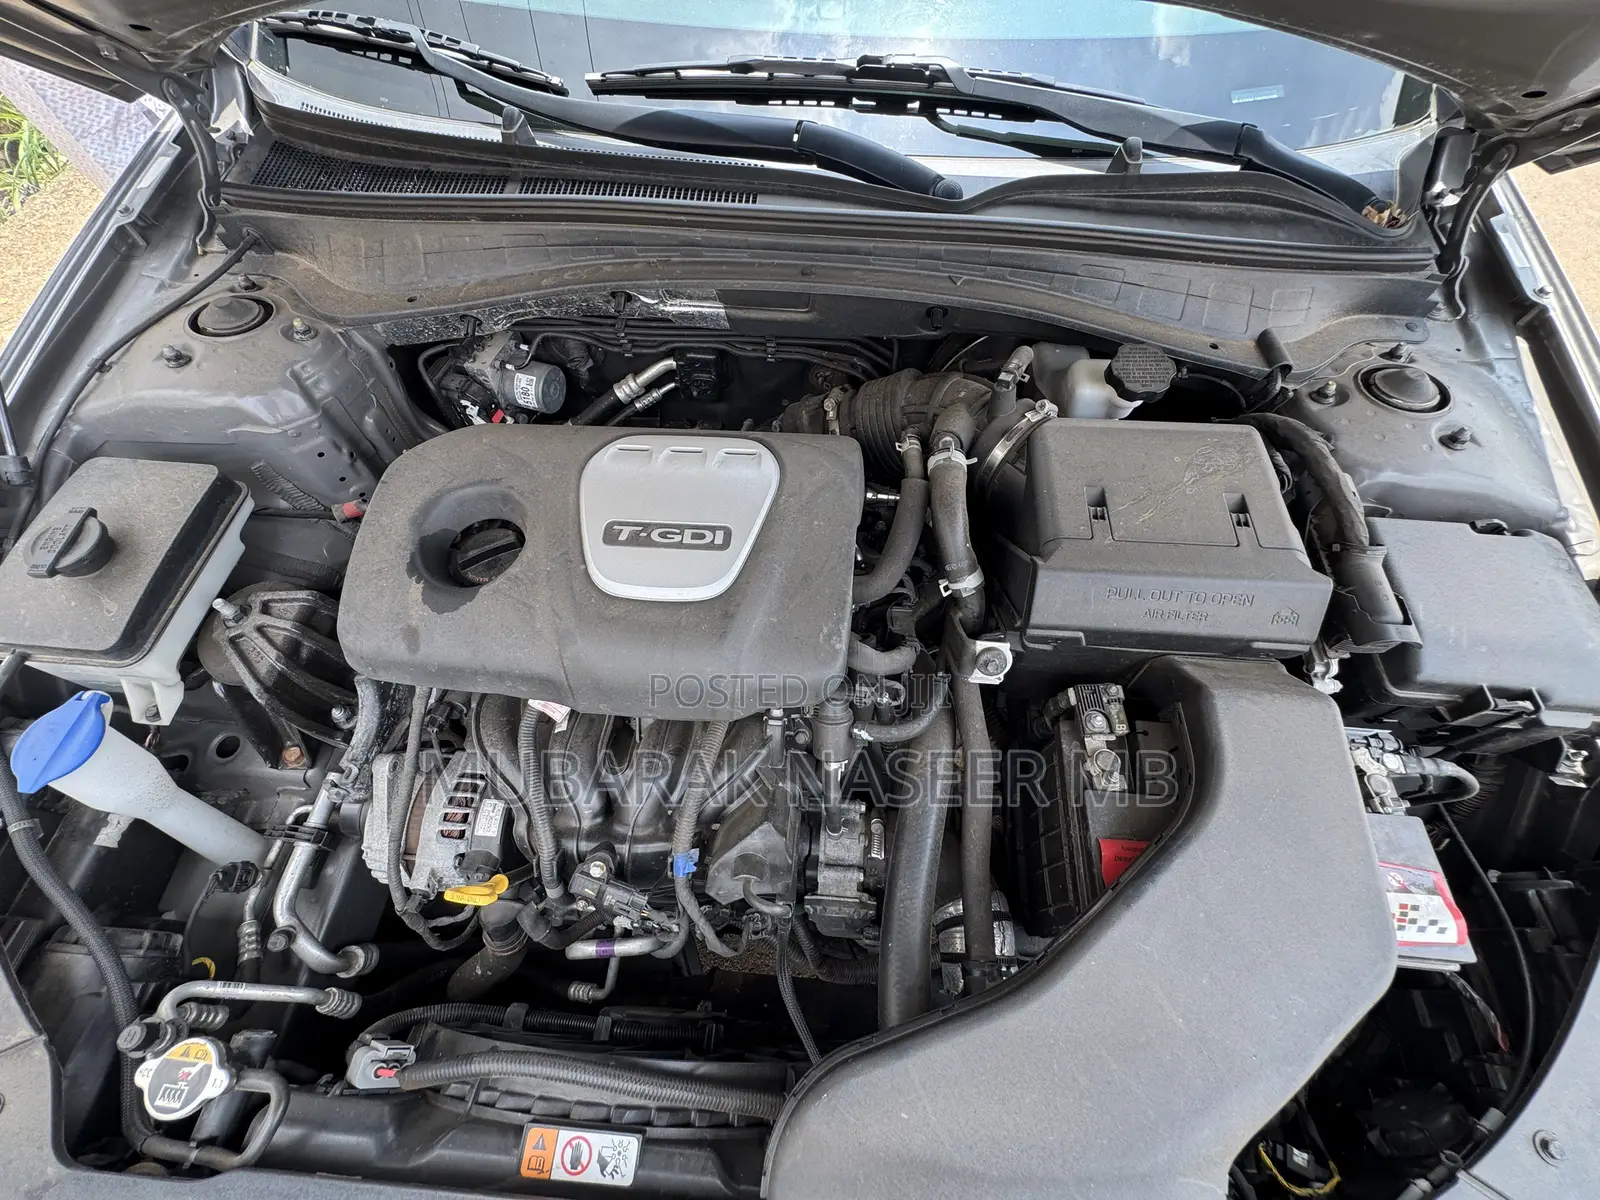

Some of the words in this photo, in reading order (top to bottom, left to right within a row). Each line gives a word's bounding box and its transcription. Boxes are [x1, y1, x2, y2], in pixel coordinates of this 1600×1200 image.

[1106, 587, 1143, 601] PULL
[1150, 589, 1183, 604] OUT
[1187, 591, 1206, 604] TO
[1211, 592, 1255, 607] OPEN
[1141, 608, 1163, 619] AIR
[1167, 609, 1209, 622] FILTER
